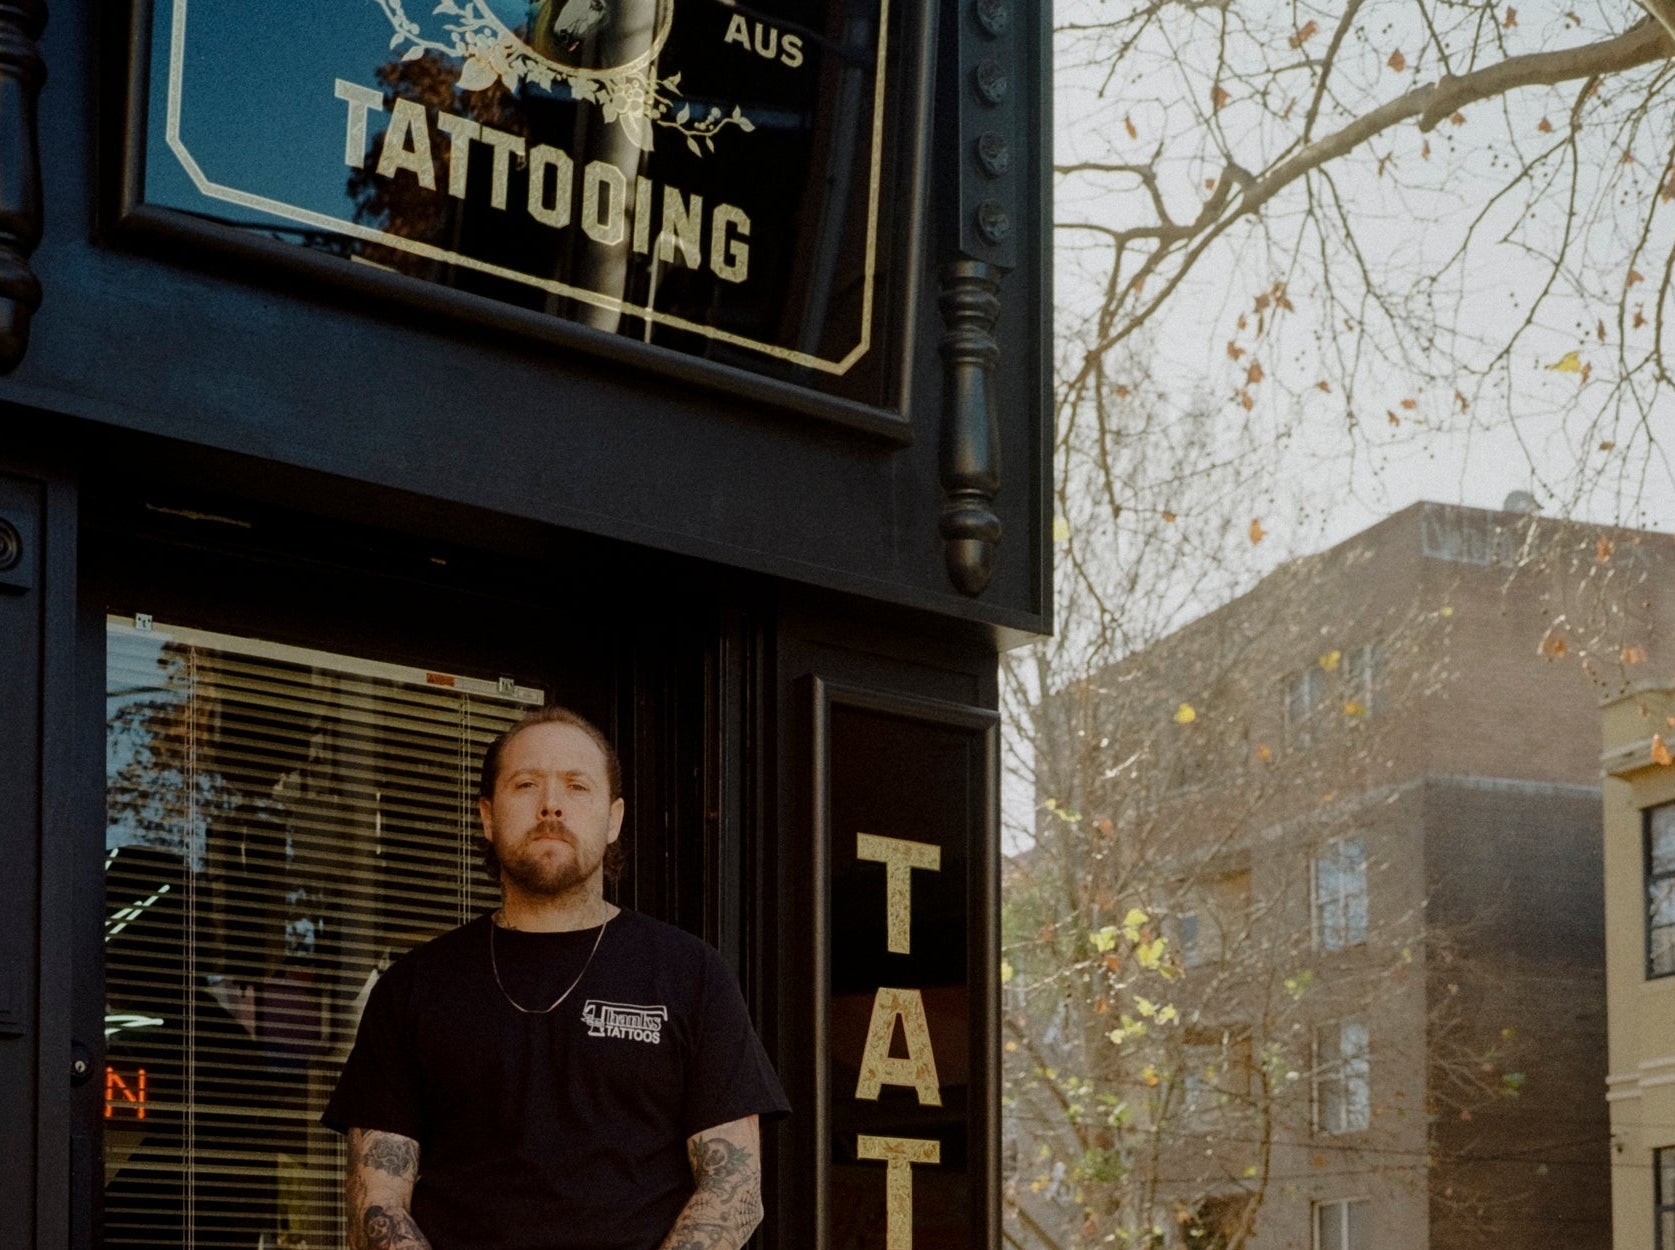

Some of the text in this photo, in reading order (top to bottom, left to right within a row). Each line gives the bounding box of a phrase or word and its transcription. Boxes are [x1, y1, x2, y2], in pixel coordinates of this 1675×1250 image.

[724, 13, 805, 69] AUS
[334, 78, 751, 285] TATTOOING
[606, 1025, 661, 1044] TATTOOS
